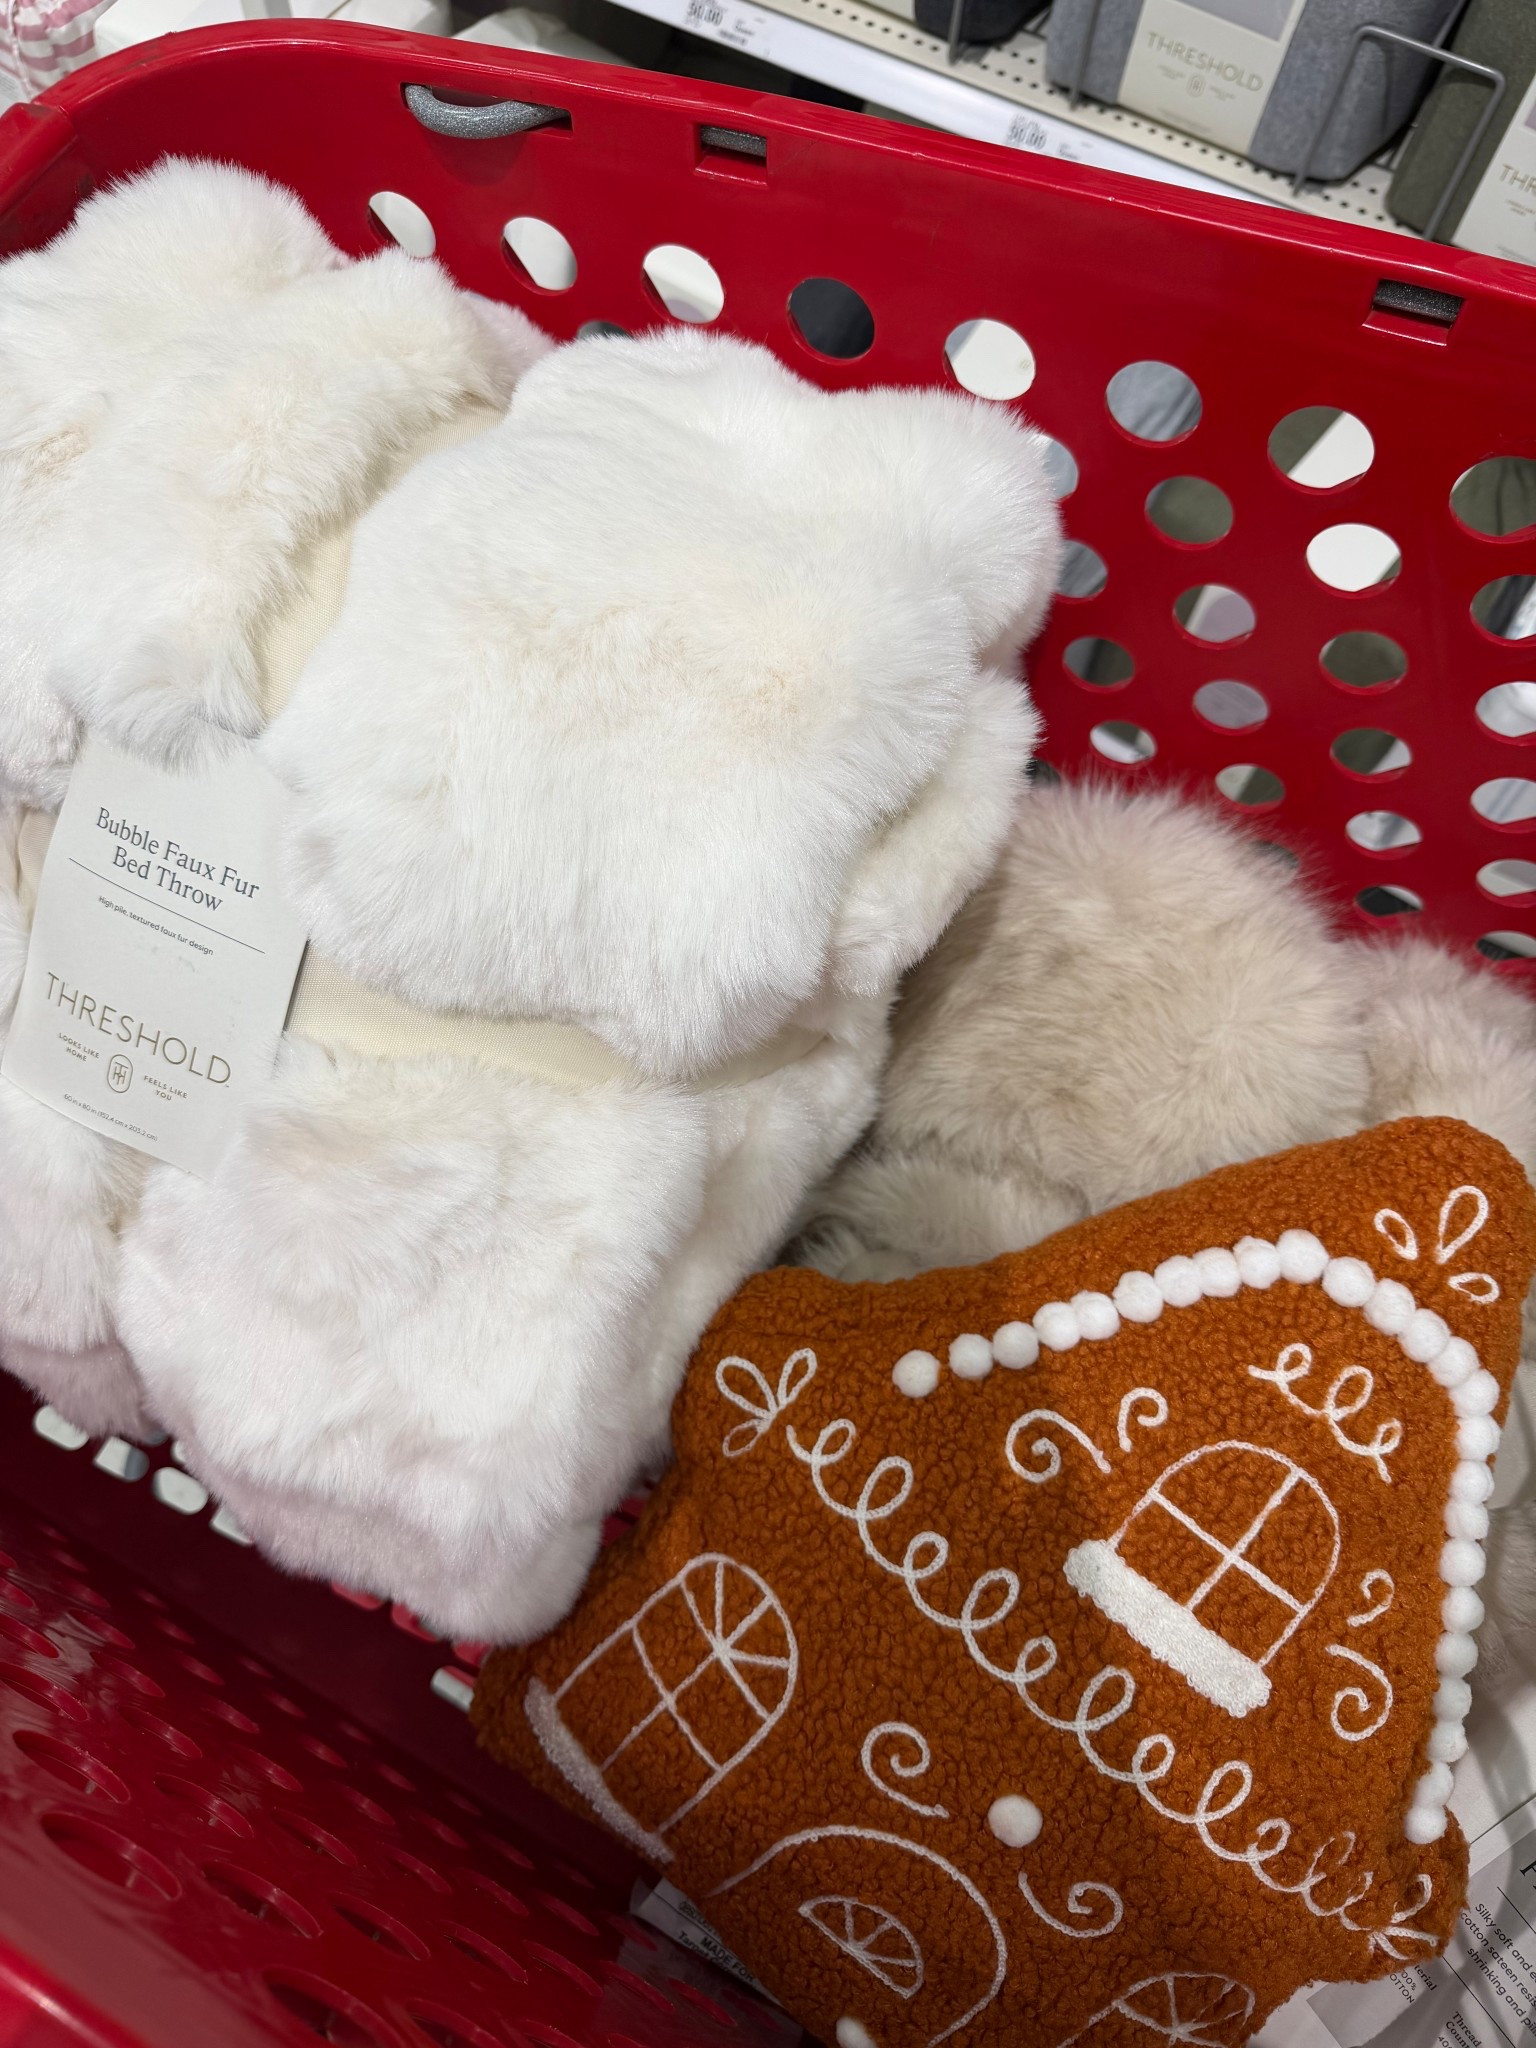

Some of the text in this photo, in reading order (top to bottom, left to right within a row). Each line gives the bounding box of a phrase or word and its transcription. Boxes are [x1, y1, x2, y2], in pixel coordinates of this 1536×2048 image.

[1147, 31, 1264, 92] THRESHOLD
[96, 806, 260, 899] Bubble Faux Fur
[112, 845, 224, 912] Bed Throw
[98, 895, 214, 956] High pile, textured faux fur design
[47, 971, 231, 1084] THRESHOLD
[58, 1032, 100, 1059] LOOKS LIKE
[65, 1046, 88, 1062] HOME
[64, 1093, 73, 1102] 60
[143, 1075, 188, 1099] FEELS LIKE
[155, 1089, 173, 1101] YOU
[700, 1936, 734, 1966] MADE
[1460, 1911, 1536, 2011] cotton sateen resis
[1475, 1903, 1497, 1928] Silky
[1494, 1928, 1514, 1950] soft
[1511, 1949, 1533, 1972] and
[1467, 1948, 1507, 1996] shrinking
[1505, 1995, 1527, 2017] and
[1453, 2011, 1482, 2048] Thread
